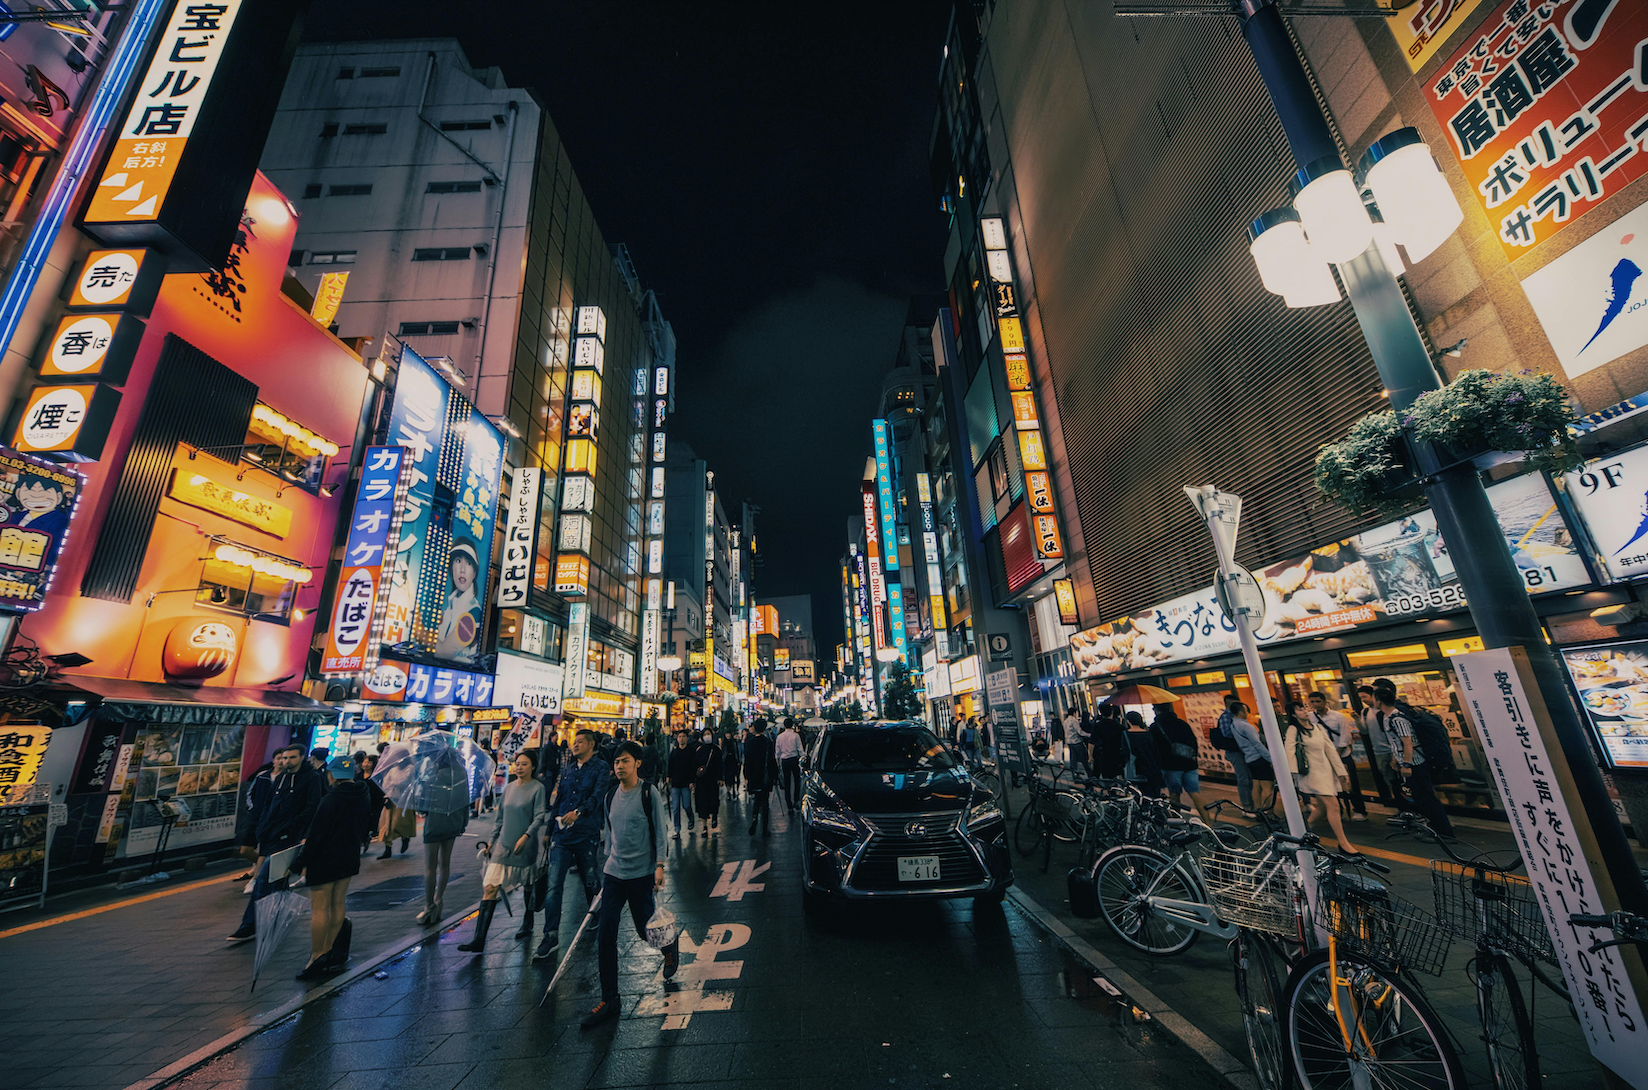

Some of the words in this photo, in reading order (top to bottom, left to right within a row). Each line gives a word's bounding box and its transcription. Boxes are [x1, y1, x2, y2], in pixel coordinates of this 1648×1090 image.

[132, 4, 229, 136] 宝ビル店
[1451, 26, 1576, 156] 居酒屋
[122, 156, 166, 169] 后方!
[132, 141, 167, 155] 右斜
[516, 469, 531, 525] しゃぶしゃぶ
[1579, 462, 1624, 497] 9F
[350, 449, 400, 565] カラオケ
[863, 493, 878, 544] SHIDAX
[502, 526, 531, 602] にいむら
[870, 562, 879, 577] BIC
[1620, 553, 1648, 567] 年中
[872, 578, 881, 603] DRUG
[337, 578, 371, 645] たばこ
[325, 656, 362, 669] 直売所
[406, 668, 494, 703] カラオケ
[520, 692, 557, 710] にいむら
